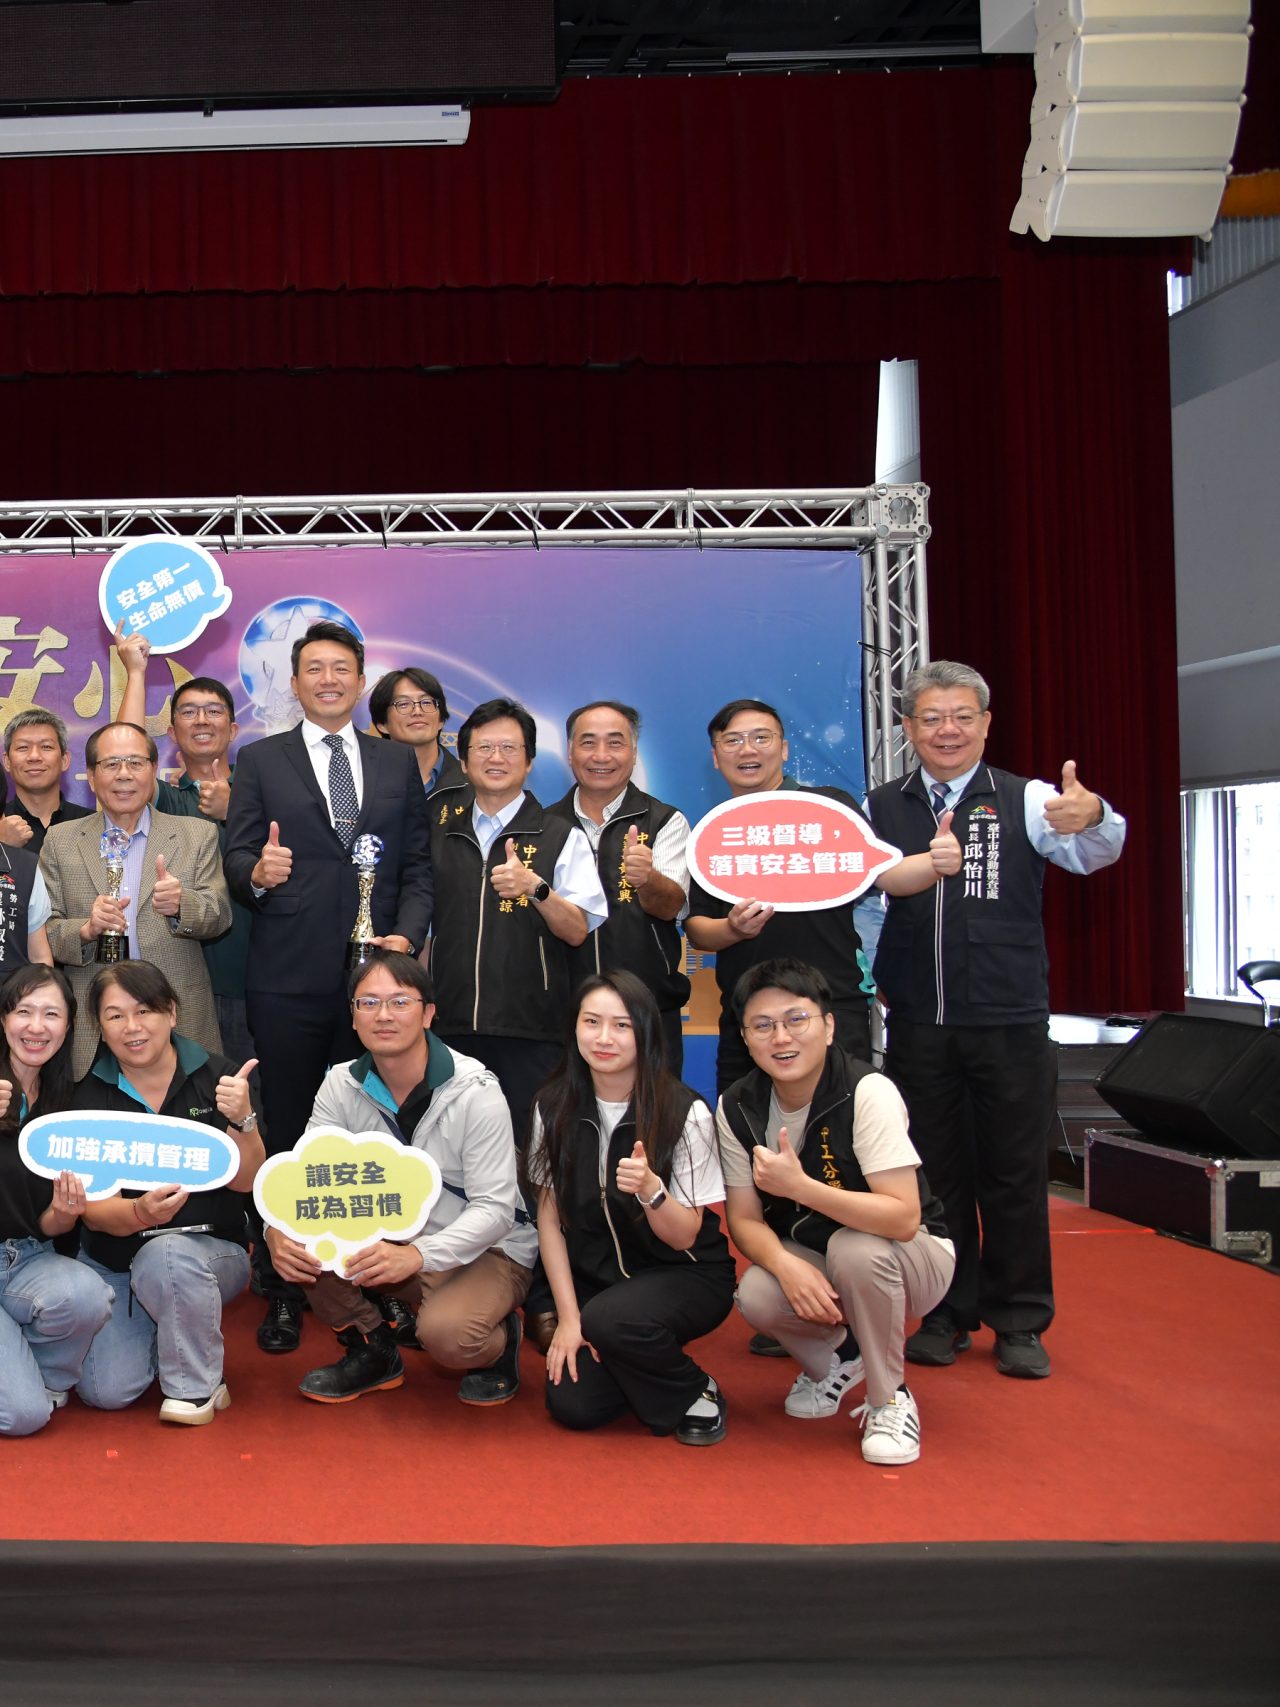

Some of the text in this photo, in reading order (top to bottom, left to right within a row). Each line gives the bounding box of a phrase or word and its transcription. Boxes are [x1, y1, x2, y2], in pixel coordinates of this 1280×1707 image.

[116, 562, 190, 610] 安全第一
[128, 579, 205, 632] 生命無價
[721, 822, 841, 847] 三級督導，
[709, 851, 865, 877] 落實安全管理
[986, 822, 1000, 899] 臺中市勞動檢查處
[8, 893, 18, 931] 勞工局
[47, 1134, 211, 1172] 加強承攬管理
[305, 1161, 387, 1188] 讓安全
[296, 1193, 403, 1221] 成為習慣
